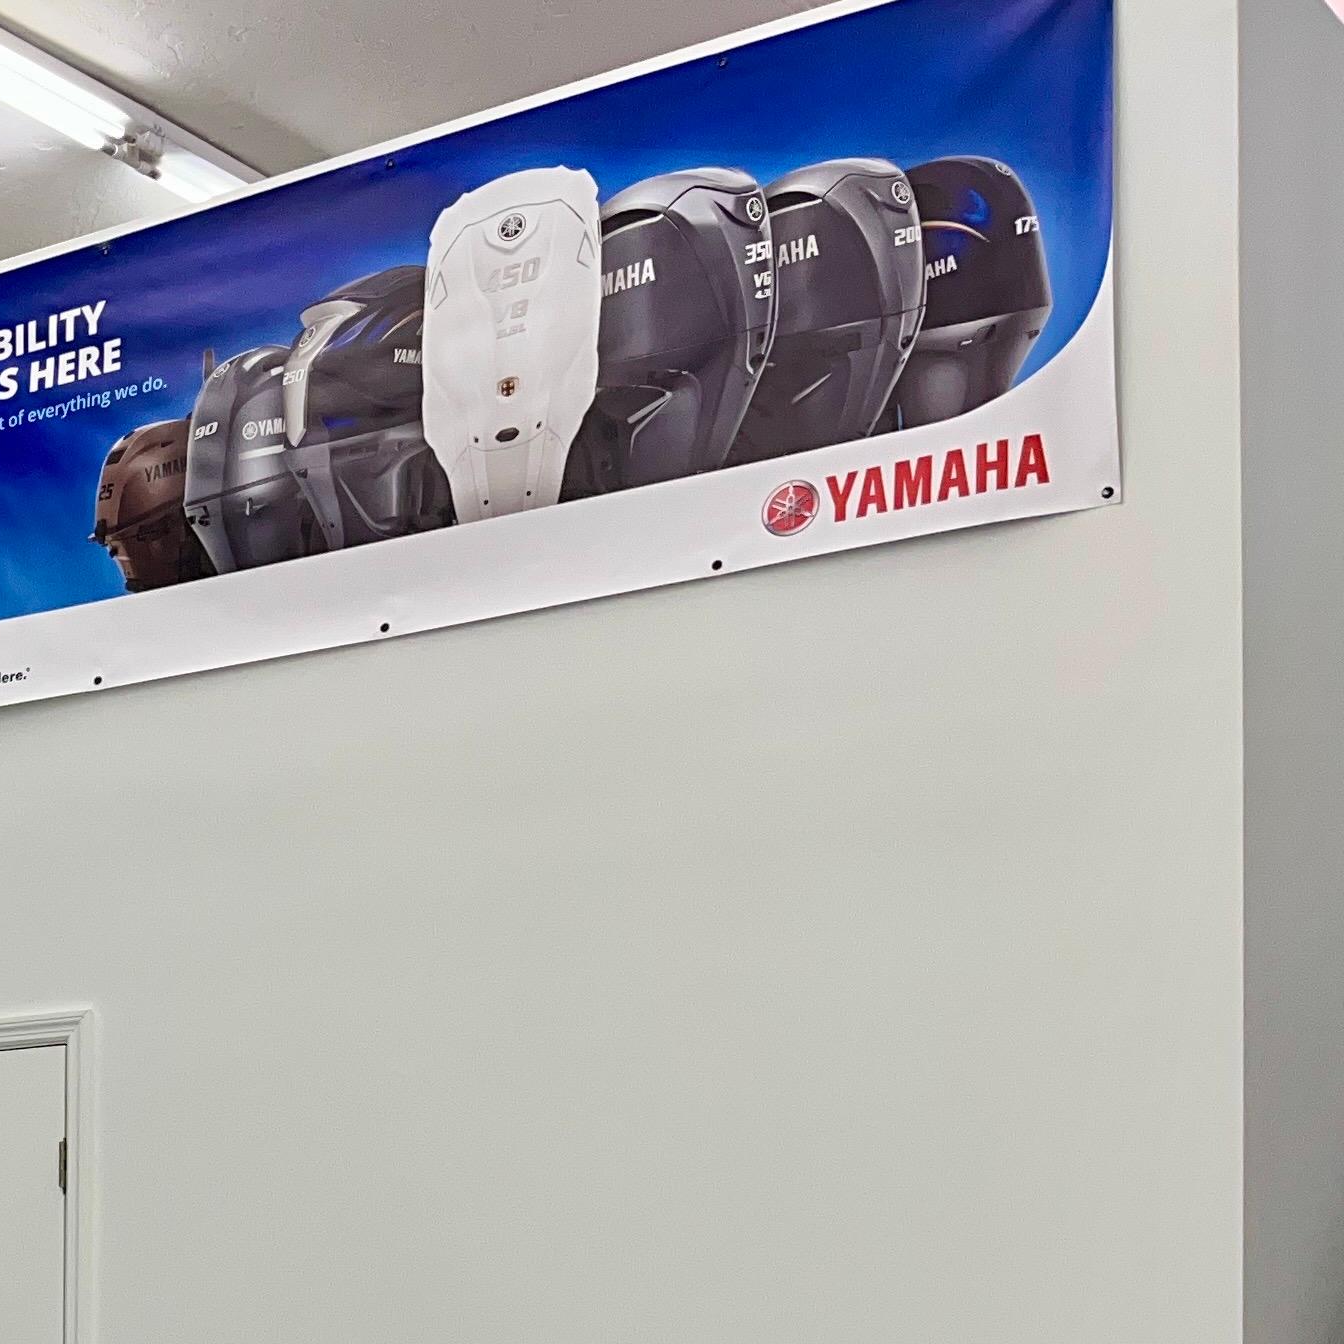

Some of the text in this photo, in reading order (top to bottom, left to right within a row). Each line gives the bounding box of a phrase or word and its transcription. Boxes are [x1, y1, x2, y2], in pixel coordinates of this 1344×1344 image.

[894, 226, 922, 247] 200
[1014, 215, 1040, 236] 175
[744, 240, 772, 265] 350
[778, 234, 820, 268] AHA
[601, 258, 656, 297] MAHA
[925, 255, 958, 280] AHA
[28, 337, 122, 394] HERE
[393, 348, 423, 365] YAMA
[282, 369, 305, 386] 250
[8, 408, 26, 428] of
[27, 390, 111, 424] everything
[114, 383, 138, 401] we
[142, 375, 168, 394] do.
[193, 421, 219, 441] 90
[825, 433, 1051, 523] YAMAHA
[99, 482, 115, 501] 25
